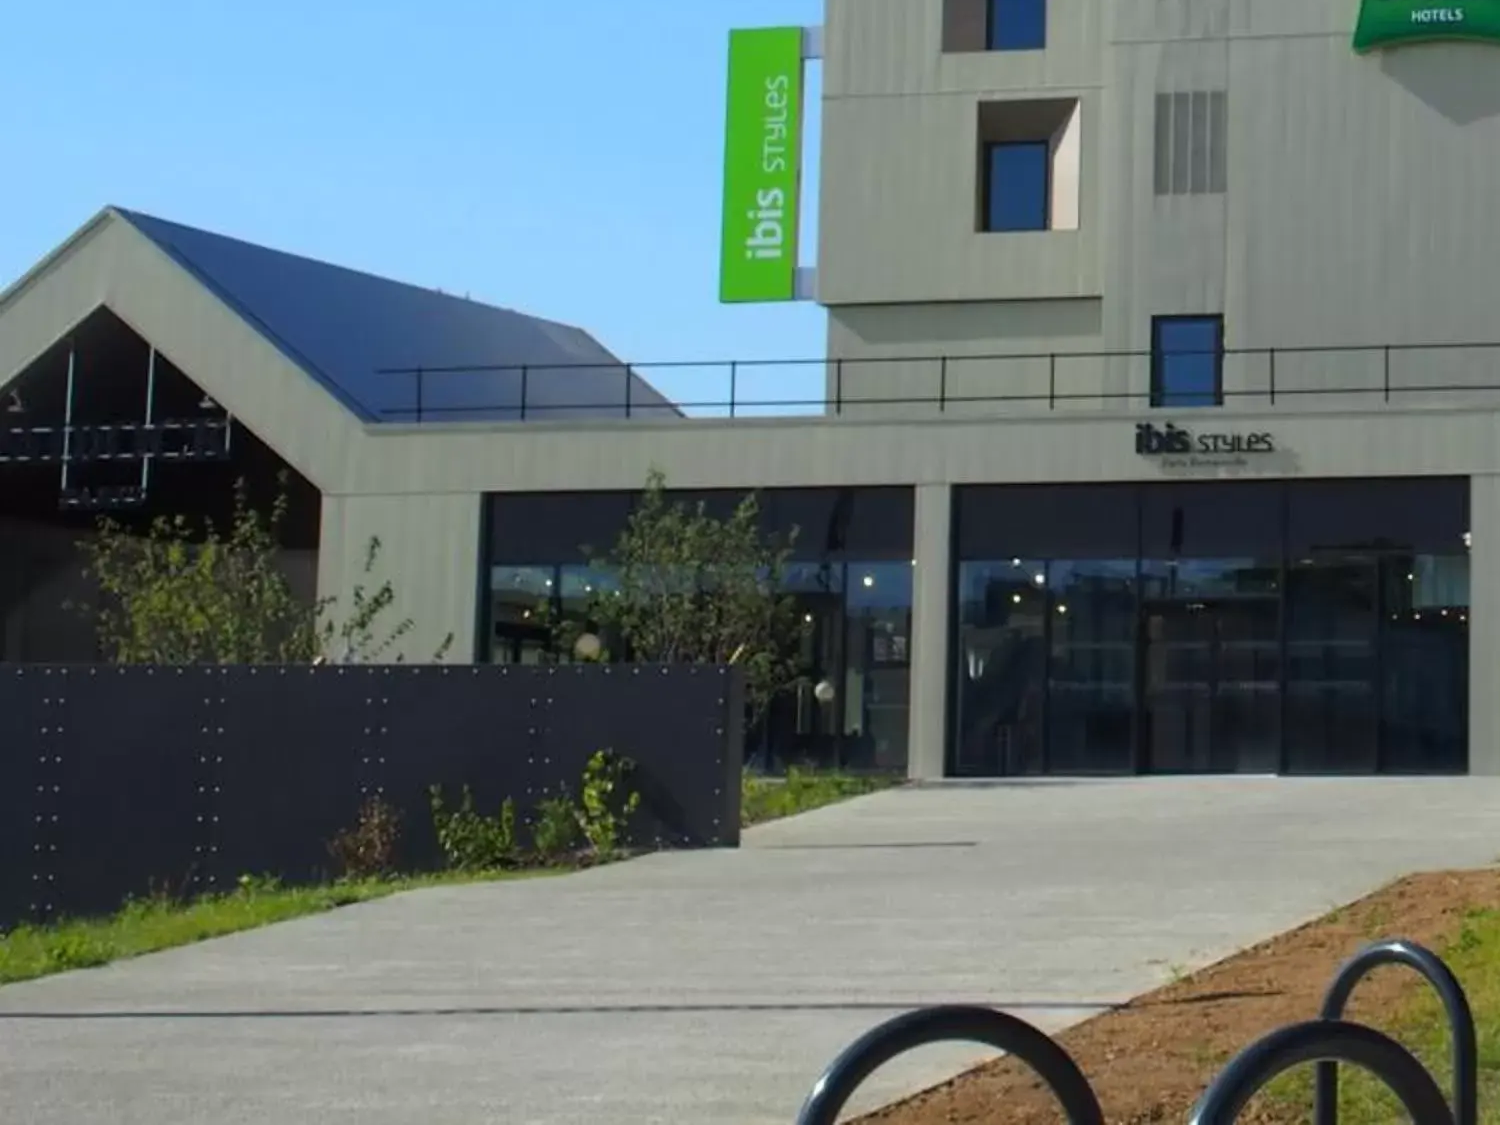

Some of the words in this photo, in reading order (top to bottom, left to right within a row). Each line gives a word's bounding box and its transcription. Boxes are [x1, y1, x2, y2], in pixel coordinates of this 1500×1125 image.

[1411, 8, 1464, 23] HOTELS
[745, 187, 784, 260] ibis
[1135, 421, 1191, 455] ibis
